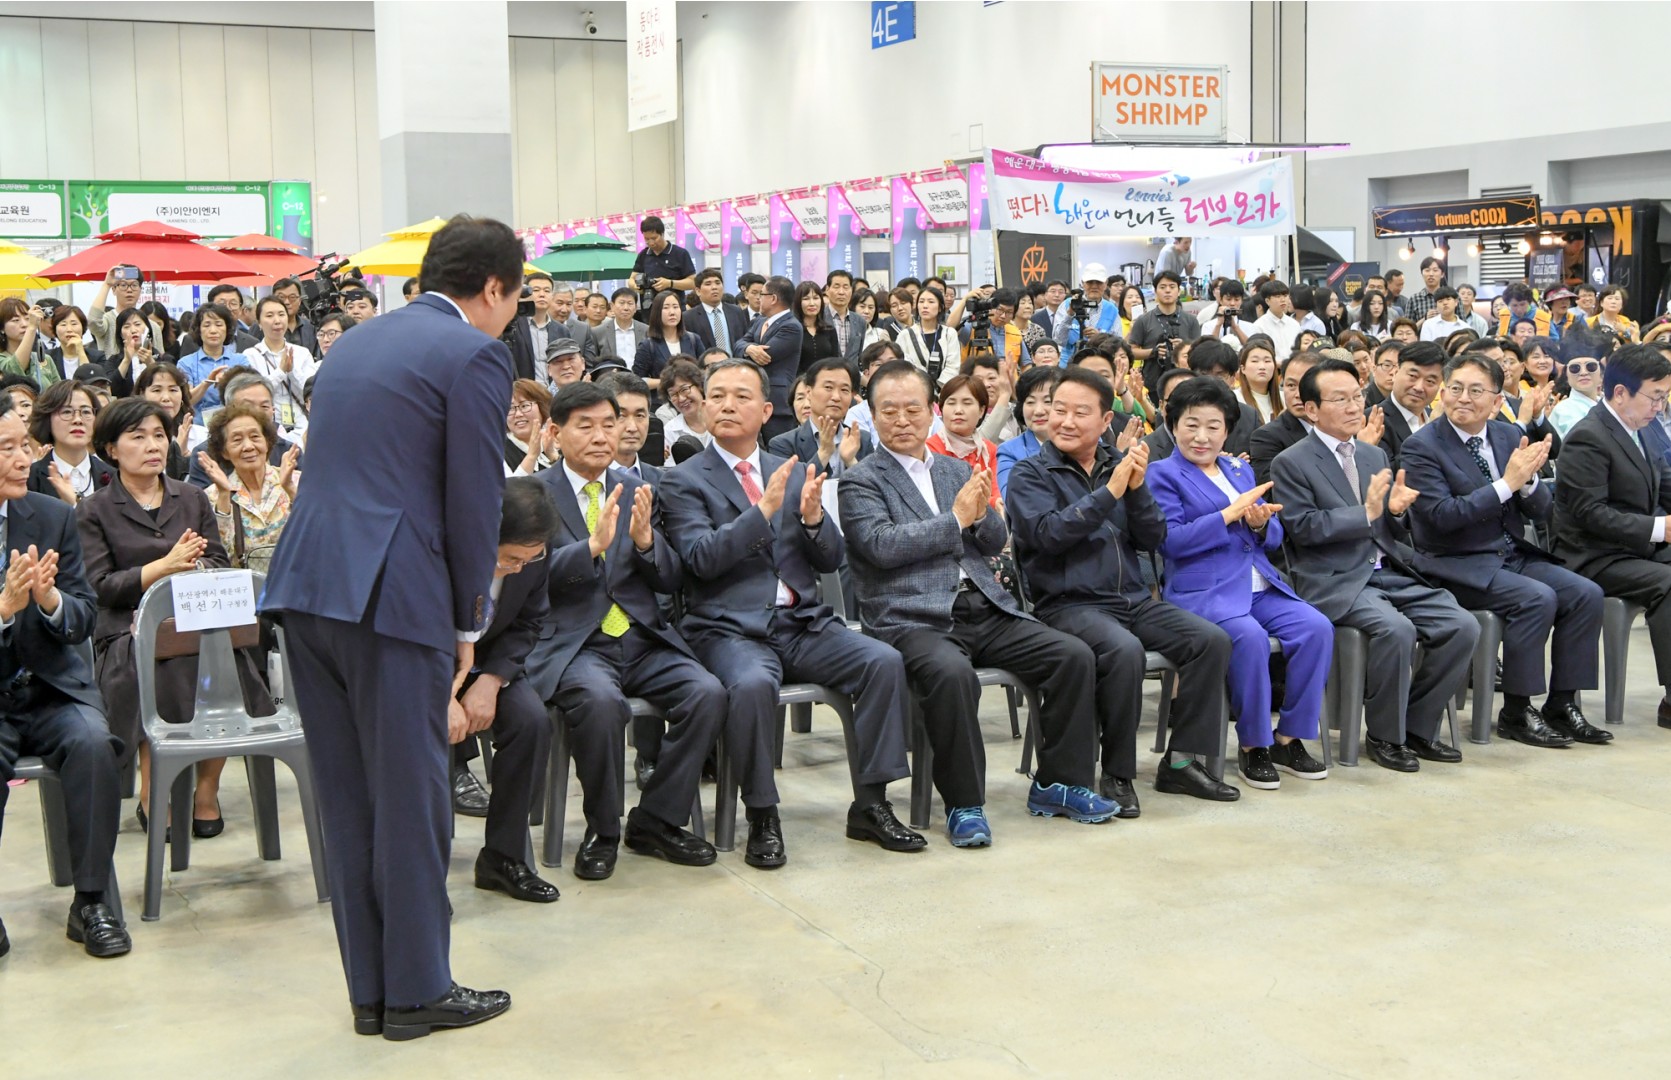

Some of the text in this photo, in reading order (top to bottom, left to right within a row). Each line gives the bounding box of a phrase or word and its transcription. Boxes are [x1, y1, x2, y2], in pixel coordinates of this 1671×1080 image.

[872, 4, 899, 44] 4E
[636, 31, 665, 58] 작품전시
[1101, 73, 1220, 98] MONSTER
[1116, 101, 1208, 126] SHRIMP
[1004, 156, 1046, 170] 해운대구
[155, 206, 221, 217] (주)이안이엔지
[282, 202, 304, 211] C-12
[1007, 194, 1050, 220] 떴다!
[1053, 182, 1110, 229] 해운대
[1114, 207, 1176, 233] 언니들
[178, 585, 248, 599] 부산광역시 해운대구
